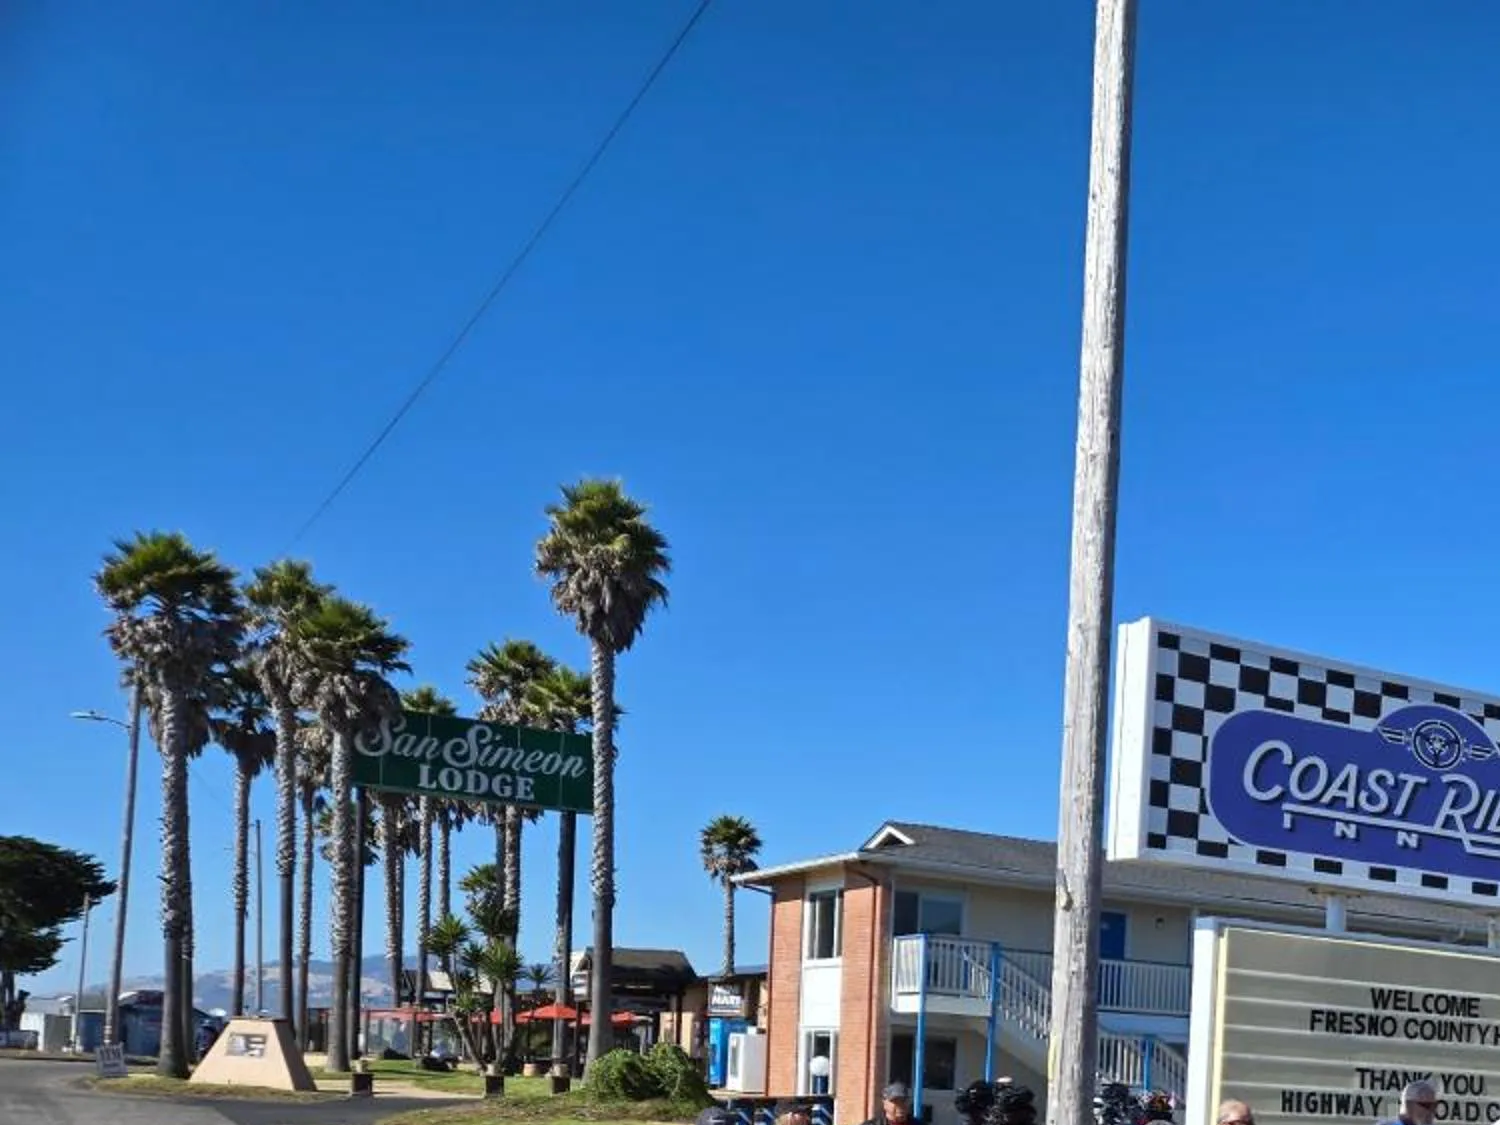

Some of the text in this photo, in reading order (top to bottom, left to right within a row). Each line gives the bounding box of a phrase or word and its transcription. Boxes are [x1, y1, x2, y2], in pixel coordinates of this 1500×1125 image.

[354, 714, 587, 778] San Simeon
[417, 763, 535, 801] LODGE
[1242, 739, 1429, 818] COAST
[1281, 804, 1421, 850] INN
[1370, 987, 1481, 1018] WELCOME
[1309, 1008, 1398, 1039] FRESNO
[1403, 1017, 1491, 1045] COUNTY
[1440, 1073, 1485, 1097] YOU
[1280, 1089, 1383, 1118] HIGHWAY
[1434, 1099, 1481, 1123] OAD
